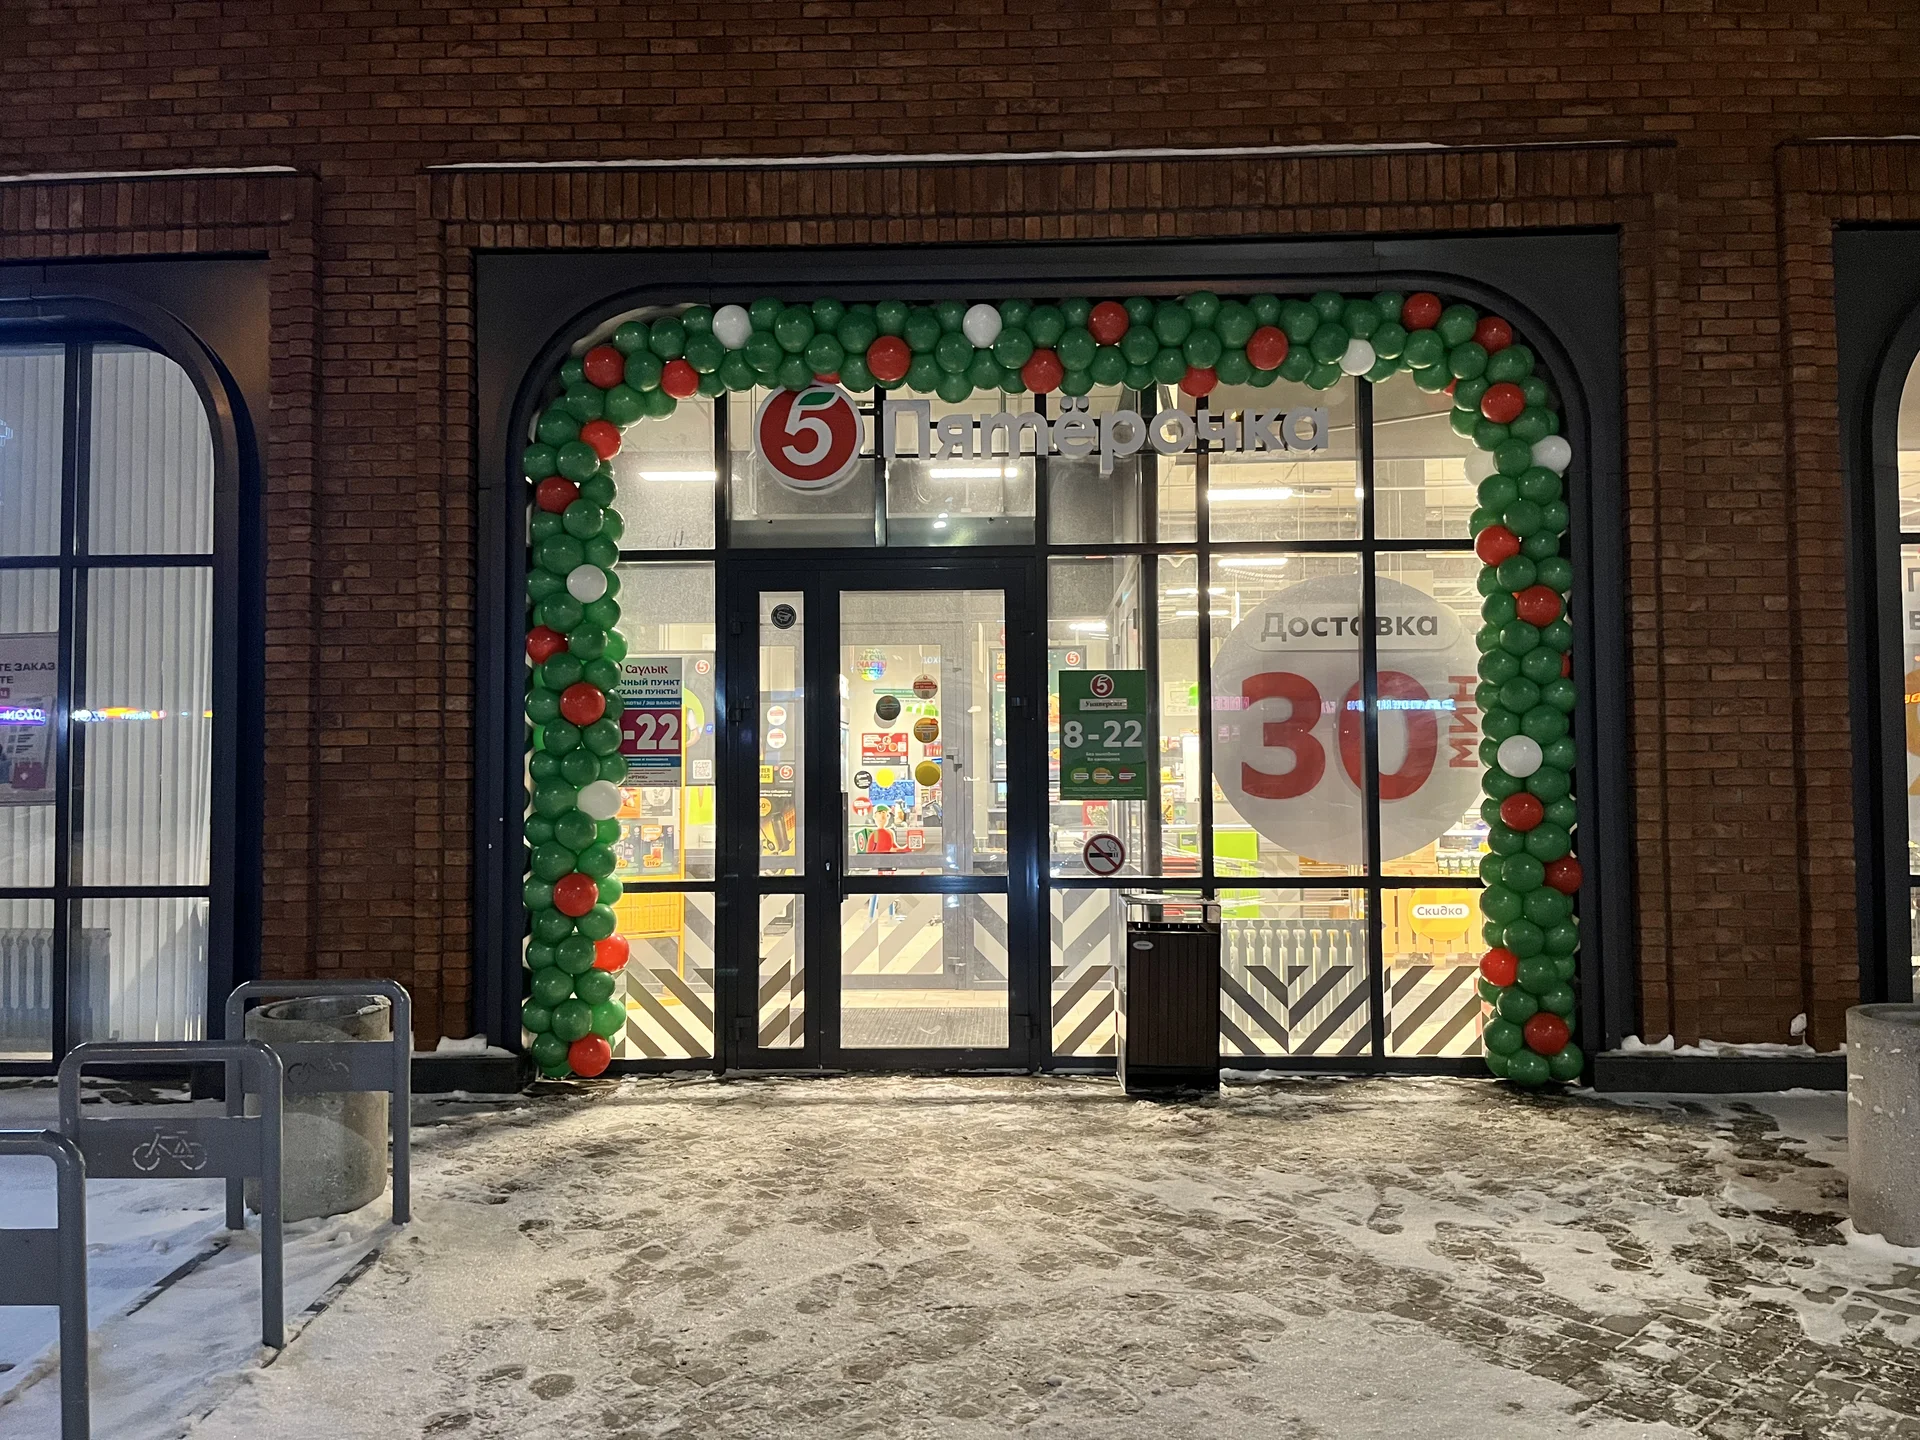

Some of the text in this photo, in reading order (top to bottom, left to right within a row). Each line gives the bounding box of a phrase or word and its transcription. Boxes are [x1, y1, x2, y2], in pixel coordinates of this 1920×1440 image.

[883, 395, 1330, 477] Пятёрочка
[14, 662, 56, 671] ЗАКАЗ
[620, 678, 648, 686] ЧНЫЙ
[622, 713, 679, 750] -22
[1241, 670, 1438, 801] 30
[1417, 905, 1463, 916] Скидка
